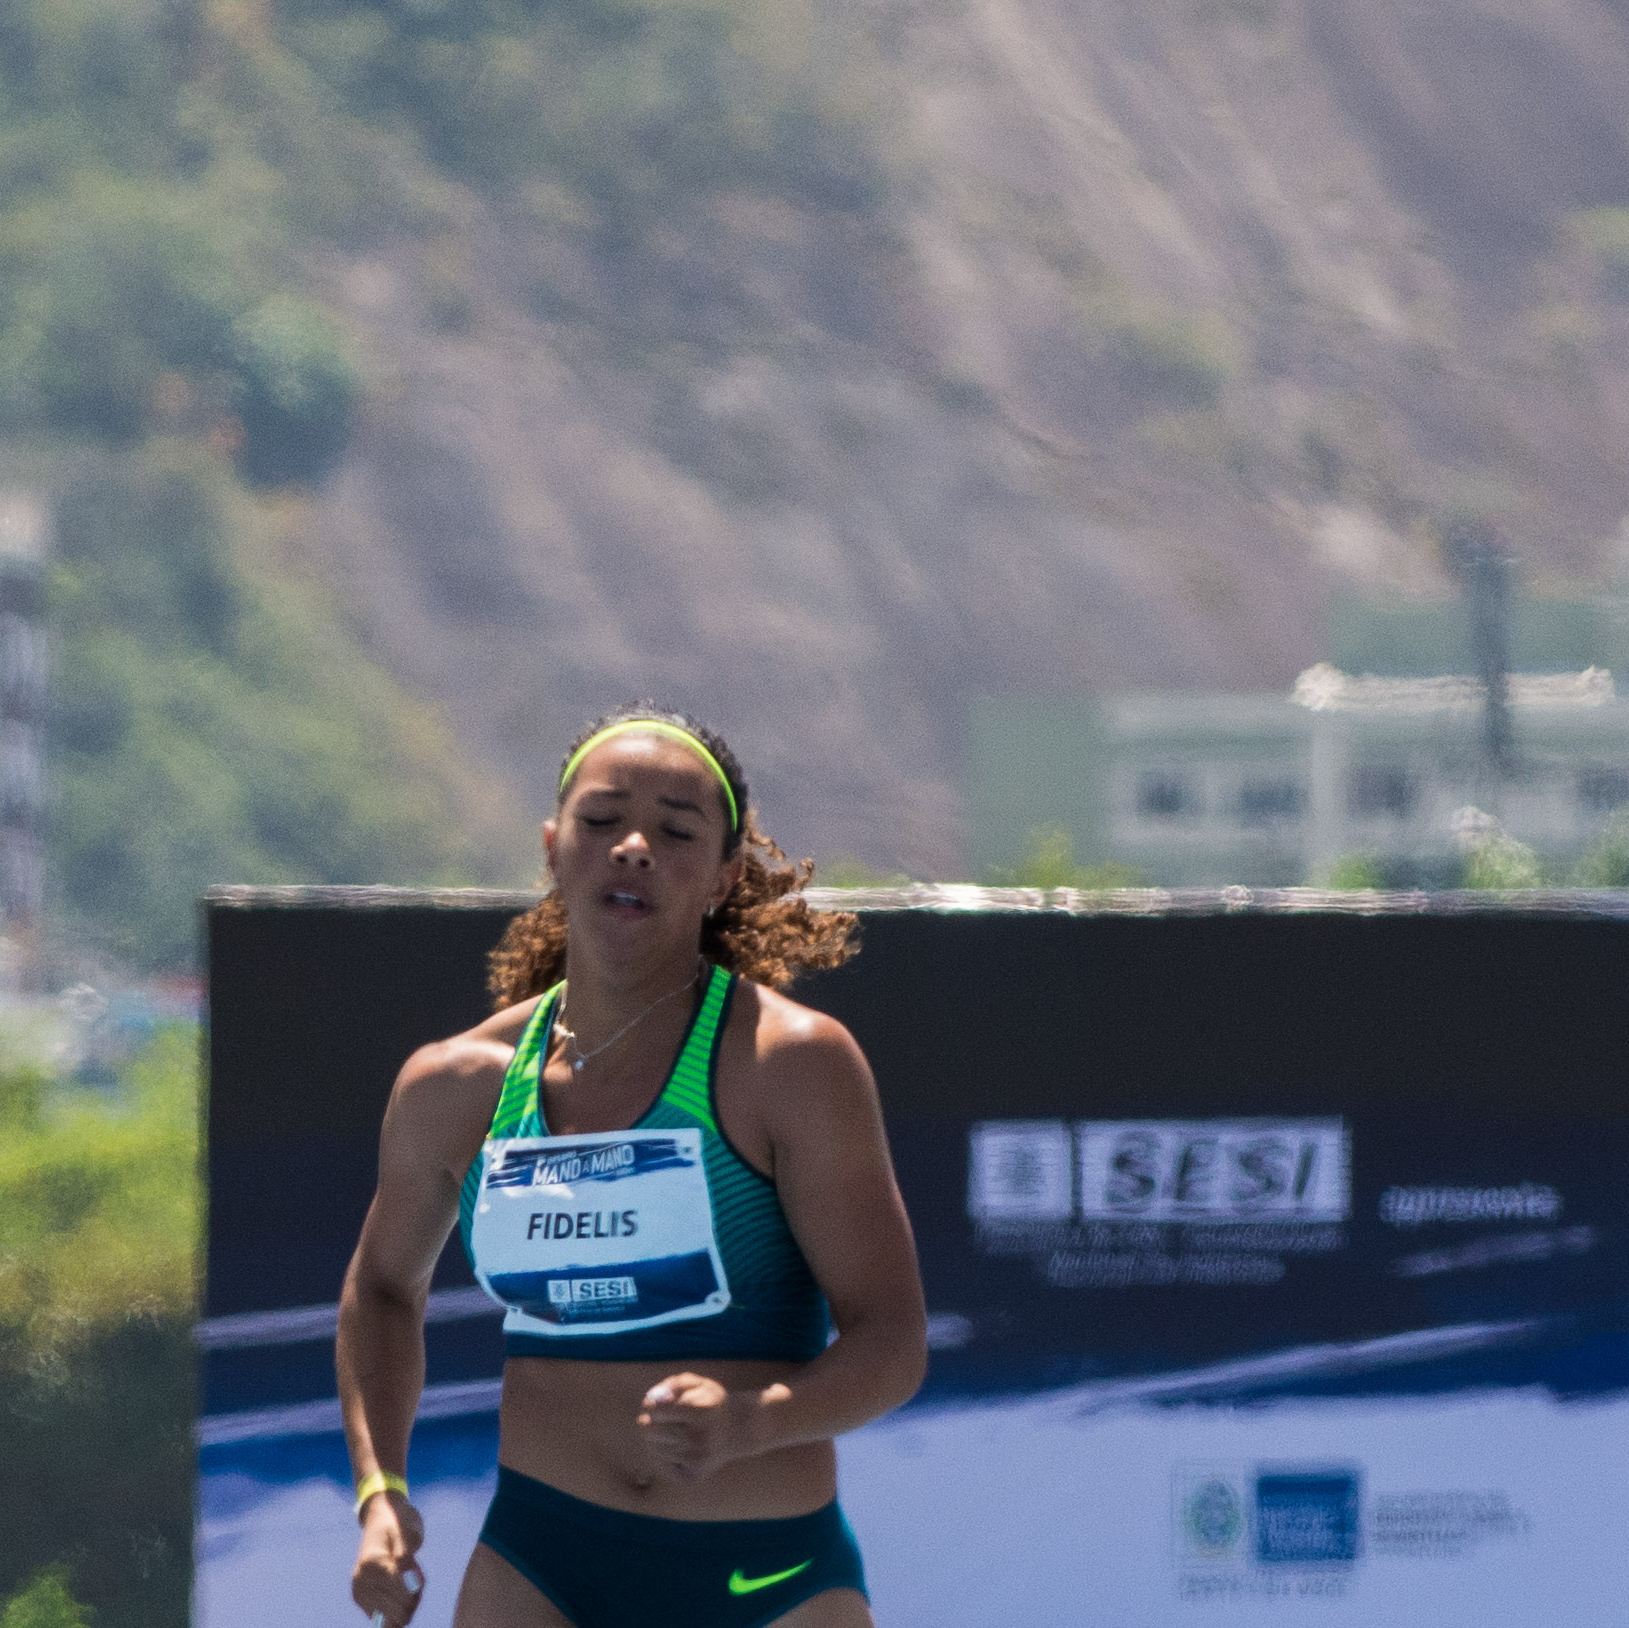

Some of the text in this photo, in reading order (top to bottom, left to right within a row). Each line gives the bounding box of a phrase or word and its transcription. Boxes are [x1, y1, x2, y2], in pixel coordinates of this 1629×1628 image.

[532, 1158, 581, 1186] MANO
[591, 1145, 635, 1175] MANO
[1104, 1130, 1318, 1212] SESI
[526, 1209, 638, 1240] FIDELIS
[579, 1279, 629, 1298] SESI
